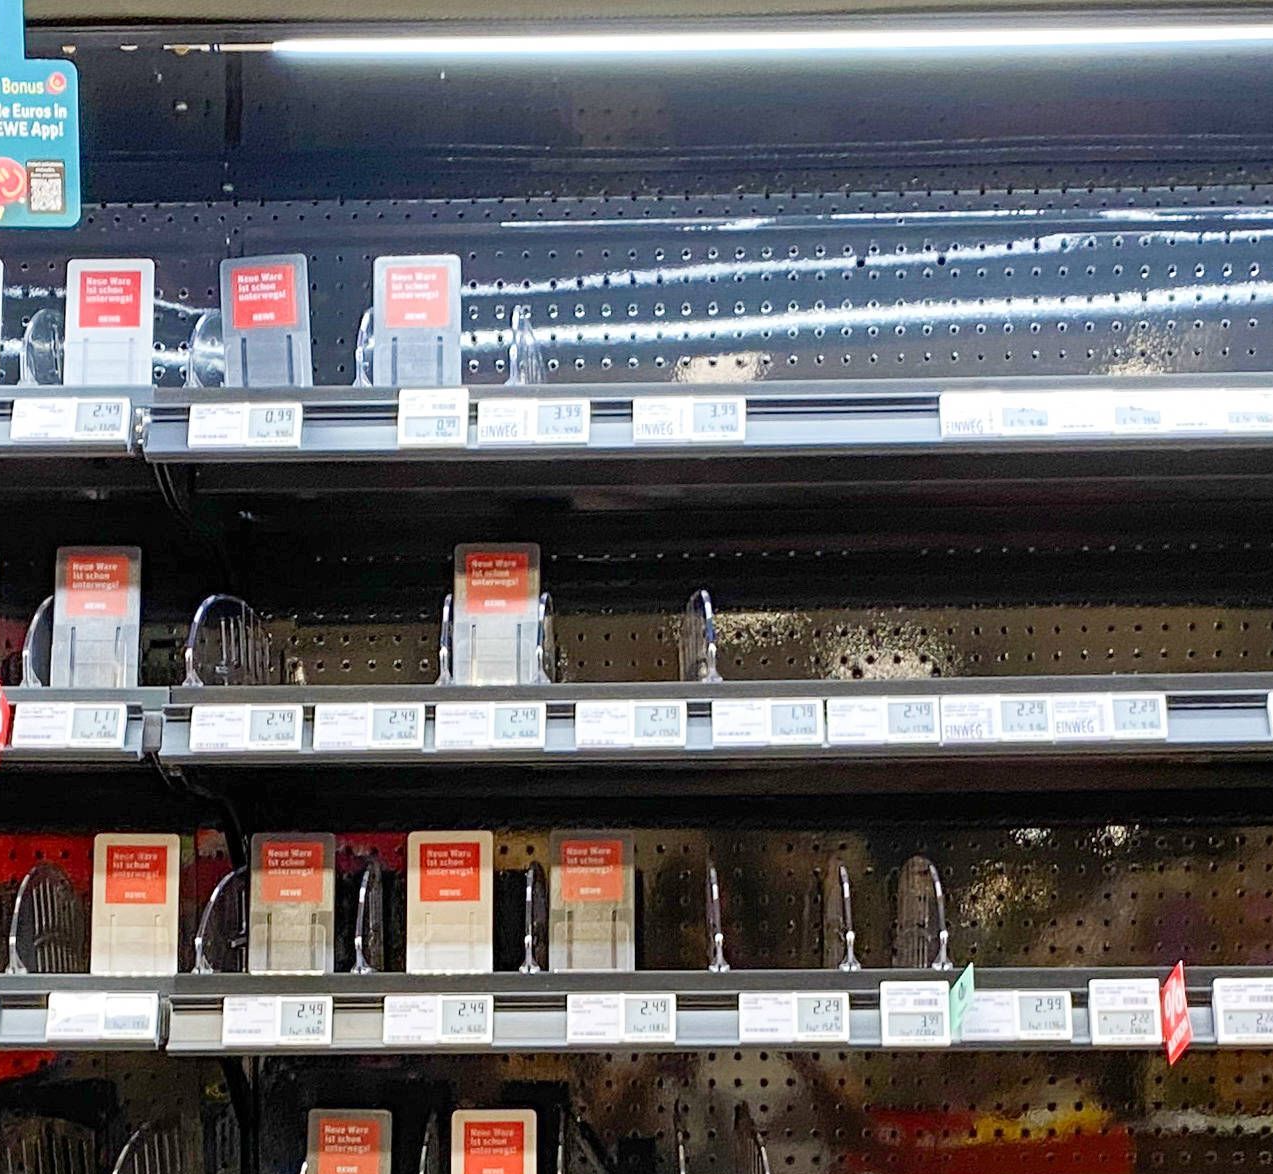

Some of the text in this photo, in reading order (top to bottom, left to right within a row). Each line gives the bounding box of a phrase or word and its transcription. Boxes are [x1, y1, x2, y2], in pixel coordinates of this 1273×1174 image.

[2, 77, 44, 94] Bonus
[12, 103, 51, 119] Euros
[54, 103, 67, 119] in
[31, 121, 63, 140] App!
[945, 722, 982, 738] EINWEG
[1056, 719, 1094, 734] EINWEG
